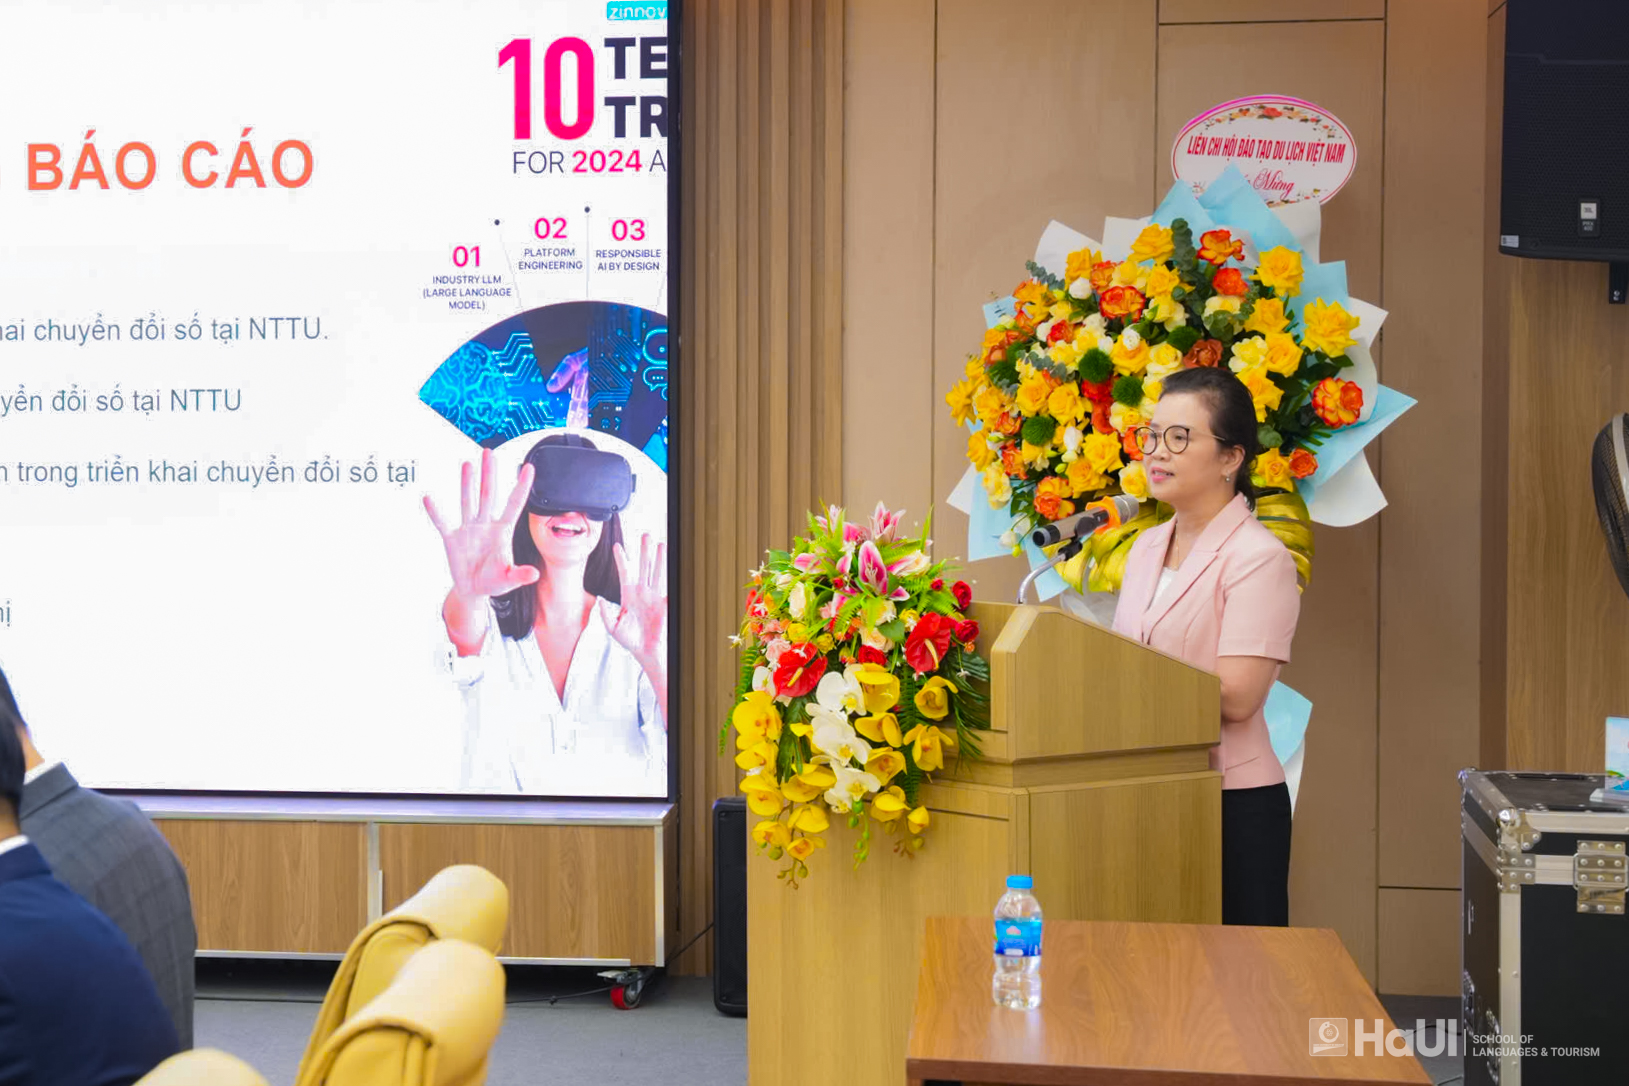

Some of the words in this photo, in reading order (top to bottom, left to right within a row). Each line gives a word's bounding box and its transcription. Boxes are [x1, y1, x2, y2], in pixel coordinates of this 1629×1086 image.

[604, 36, 668, 79] TE
[498, 36, 595, 140] 10
[604, 95, 668, 138] TR
[27, 129, 156, 191] BÁO
[182, 127, 313, 189] CÁO
[1187, 132, 1208, 155] LIÊN
[1207, 136, 1223, 156] CHI
[1272, 140, 1286, 160] DU
[1323, 142, 1346, 163] NAM
[513, 150, 564, 174] FOR
[572, 149, 642, 173] 2024
[534, 216, 567, 239] 02
[611, 218, 645, 241] 03
[452, 245, 480, 268] 01
[523, 247, 576, 258] PLATFORM
[595, 249, 661, 259] RESPONSIBLE
[518, 260, 583, 270] ENGINEERING
[608, 261, 622, 271] BY
[623, 261, 660, 271] DESIGN
[432, 275, 480, 285] INDUSTRY
[482, 275, 502, 284] LLM
[423, 288, 457, 299] (LARGE
[459, 287, 512, 297] LANGUAGE
[448, 300, 486, 311] MODEL)
[0, 318, 24, 341] ai
[34, 312, 120, 346] chuyển
[129, 312, 165, 341] đổi
[174, 311, 202, 340] số
[211, 318, 240, 344] tại
[249, 317, 328, 340] NTTU.
[52, 384, 86, 412] đổi
[96, 383, 124, 412] số
[132, 389, 160, 416] tại
[170, 389, 241, 412] NTTU
[17, 461, 78, 488] trong
[87, 454, 139, 482] triển
[149, 460, 198, 482] khai
[206, 454, 295, 488] chuyển
[304, 455, 340, 483] đổi
[349, 455, 378, 483] số
[387, 461, 415, 487] tại
